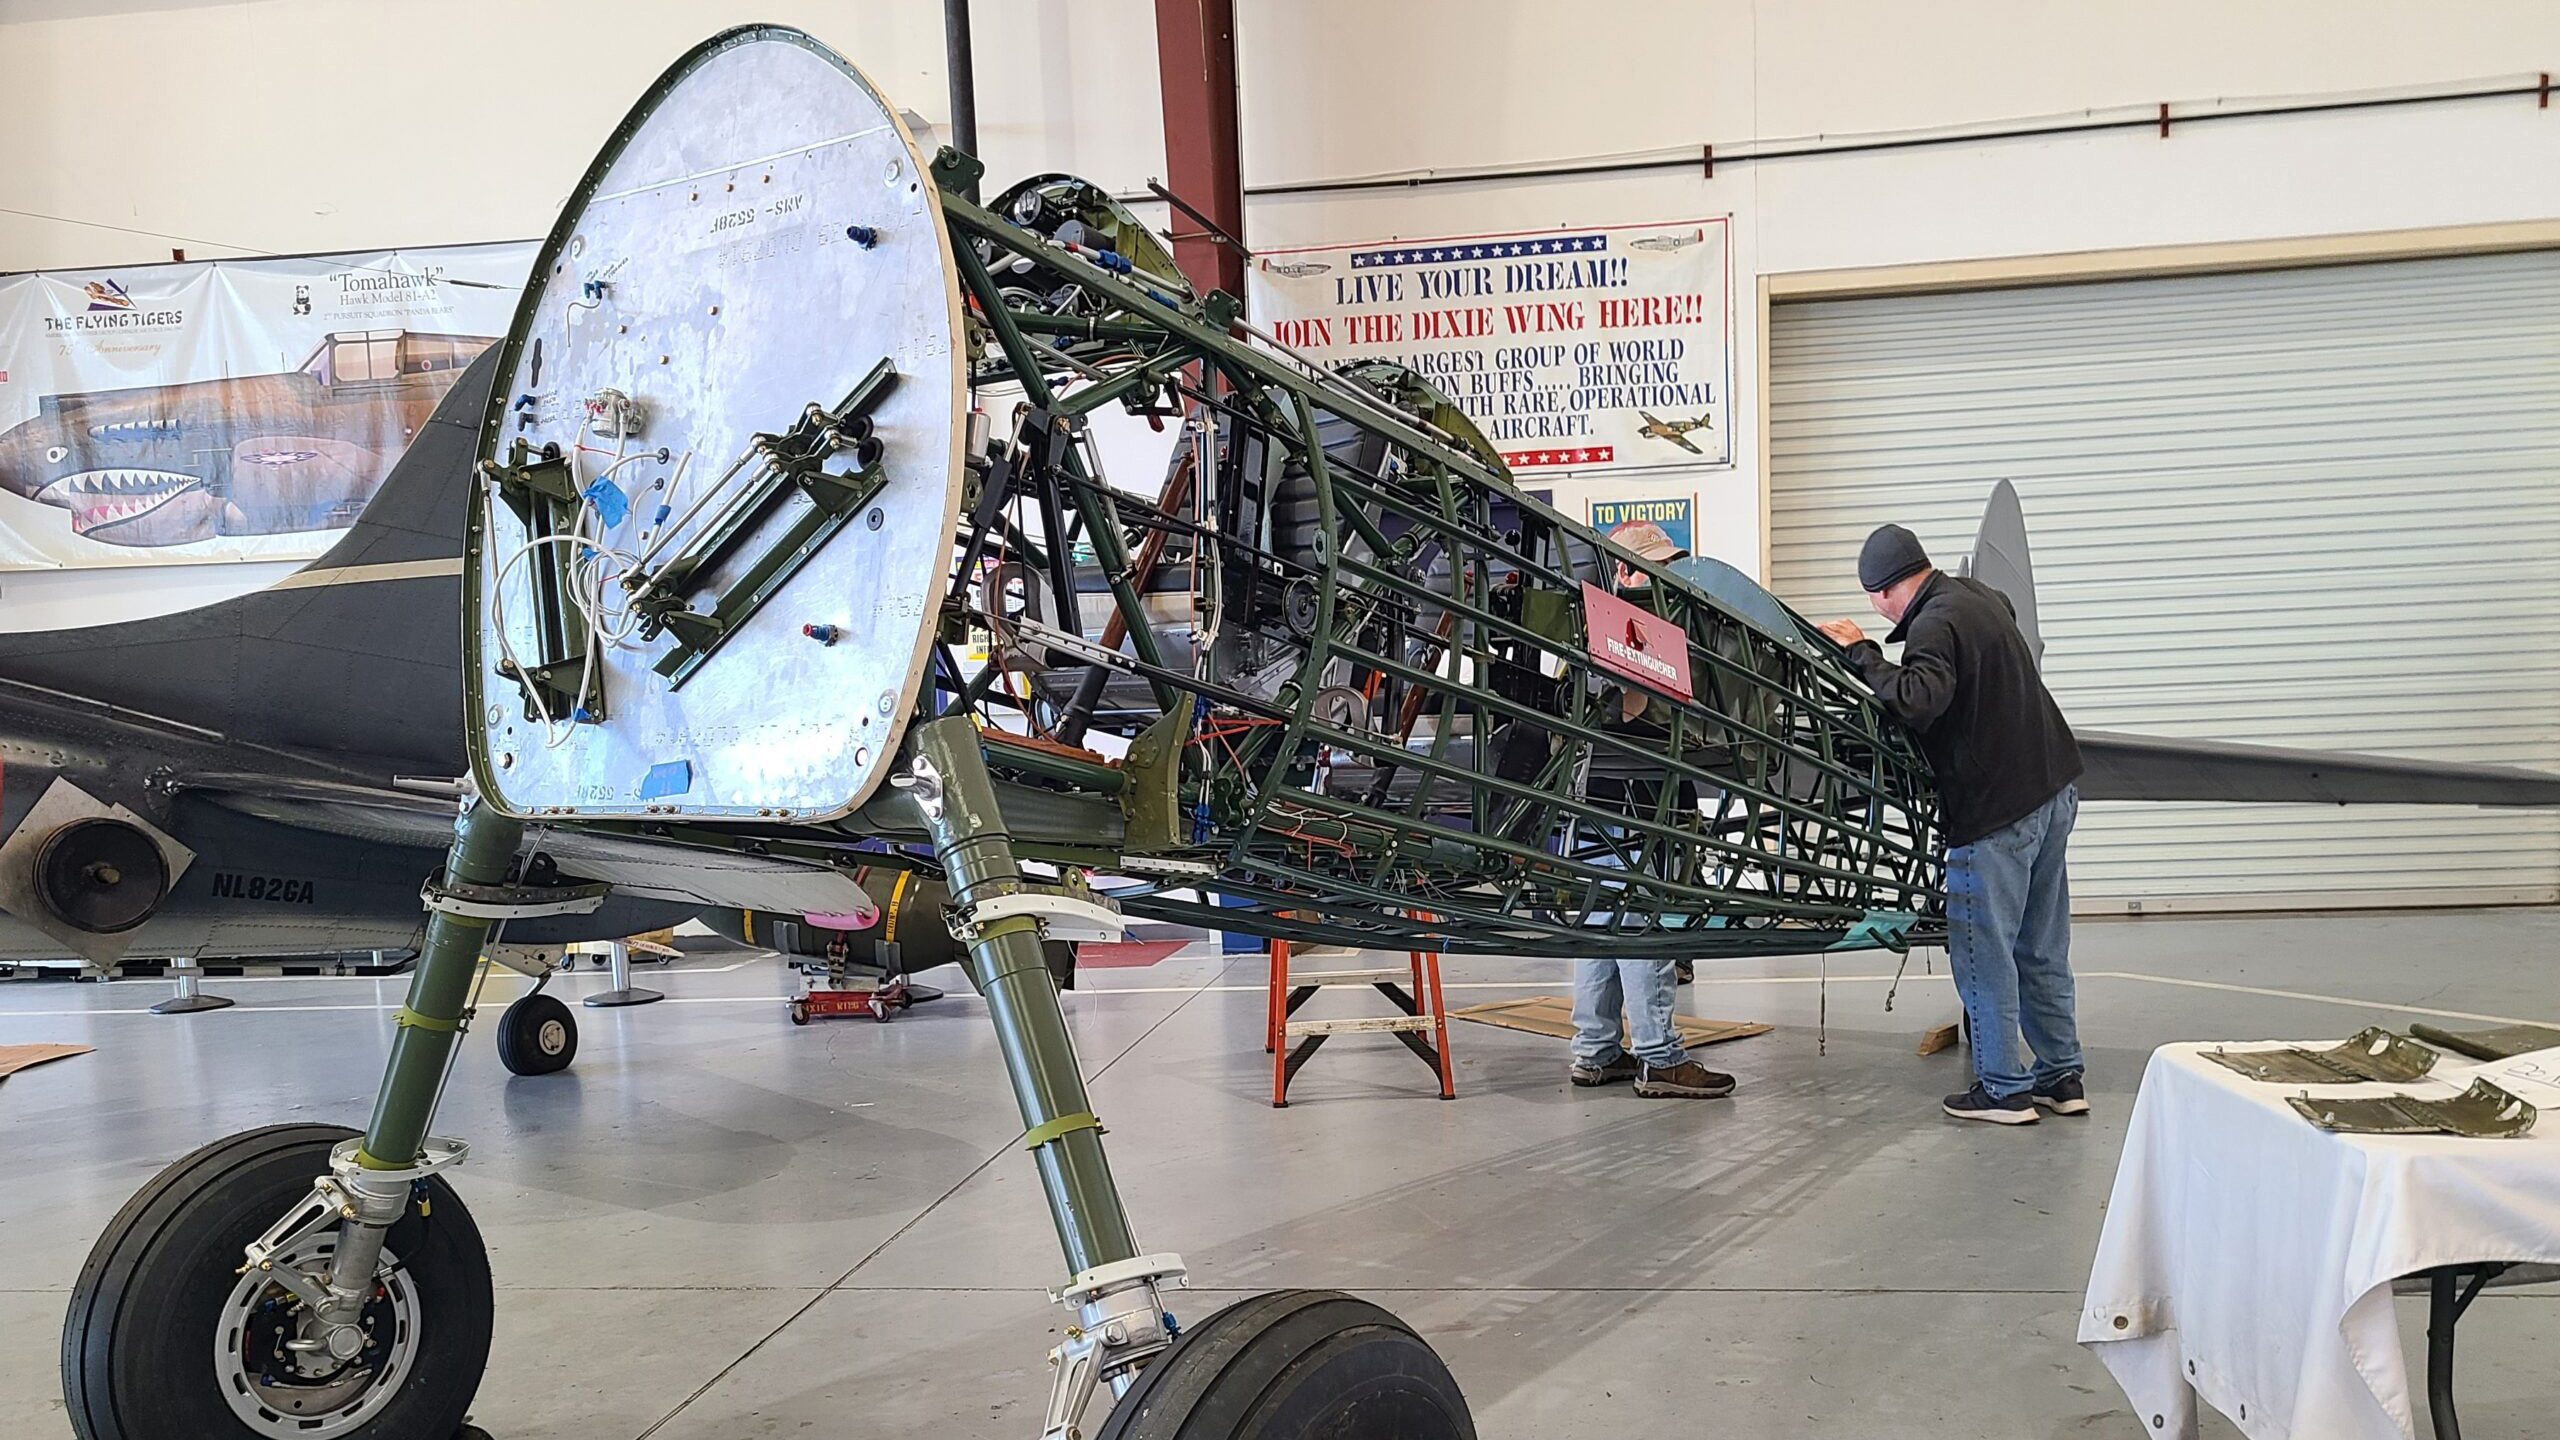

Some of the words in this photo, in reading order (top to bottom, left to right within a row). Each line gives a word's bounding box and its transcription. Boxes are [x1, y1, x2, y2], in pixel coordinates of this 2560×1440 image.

[1335, 274, 1403, 305] LIVE
[1416, 266, 1493, 300] YOUR
[1505, 257, 1628, 294] DREAM!!
[340, 294, 370, 306] Hawk
[372, 291, 403, 305] Model
[406, 289, 437, 302] 81-A2
[44, 317, 73, 331] THE
[75, 313, 129, 330] FLYING
[132, 310, 183, 326] TIGERS
[1269, 317, 1332, 349] JOIN
[1344, 313, 1403, 345] THE
[1412, 307, 1493, 341] DIXIE
[1503, 301, 1585, 335] WING
[1599, 294, 1704, 329] HERE!!
[1495, 345, 1567, 371] GROUP
[1574, 342, 1604, 366] OF
[1609, 339, 1684, 363] WORLD
[1579, 361, 1680, 388] BRINGING
[1453, 395, 1494, 417] ITH
[1504, 391, 1567, 415] RARE,
[1570, 383, 1717, 411] OPERATIONAL
[1489, 414, 1595, 441] AIRCRAFT.
[1595, 505, 1615, 525] TO
[1618, 502, 1687, 523] VICTORY
[211, 872, 314, 904] NL82GA
[803, 1003, 828, 1013] IXIE
